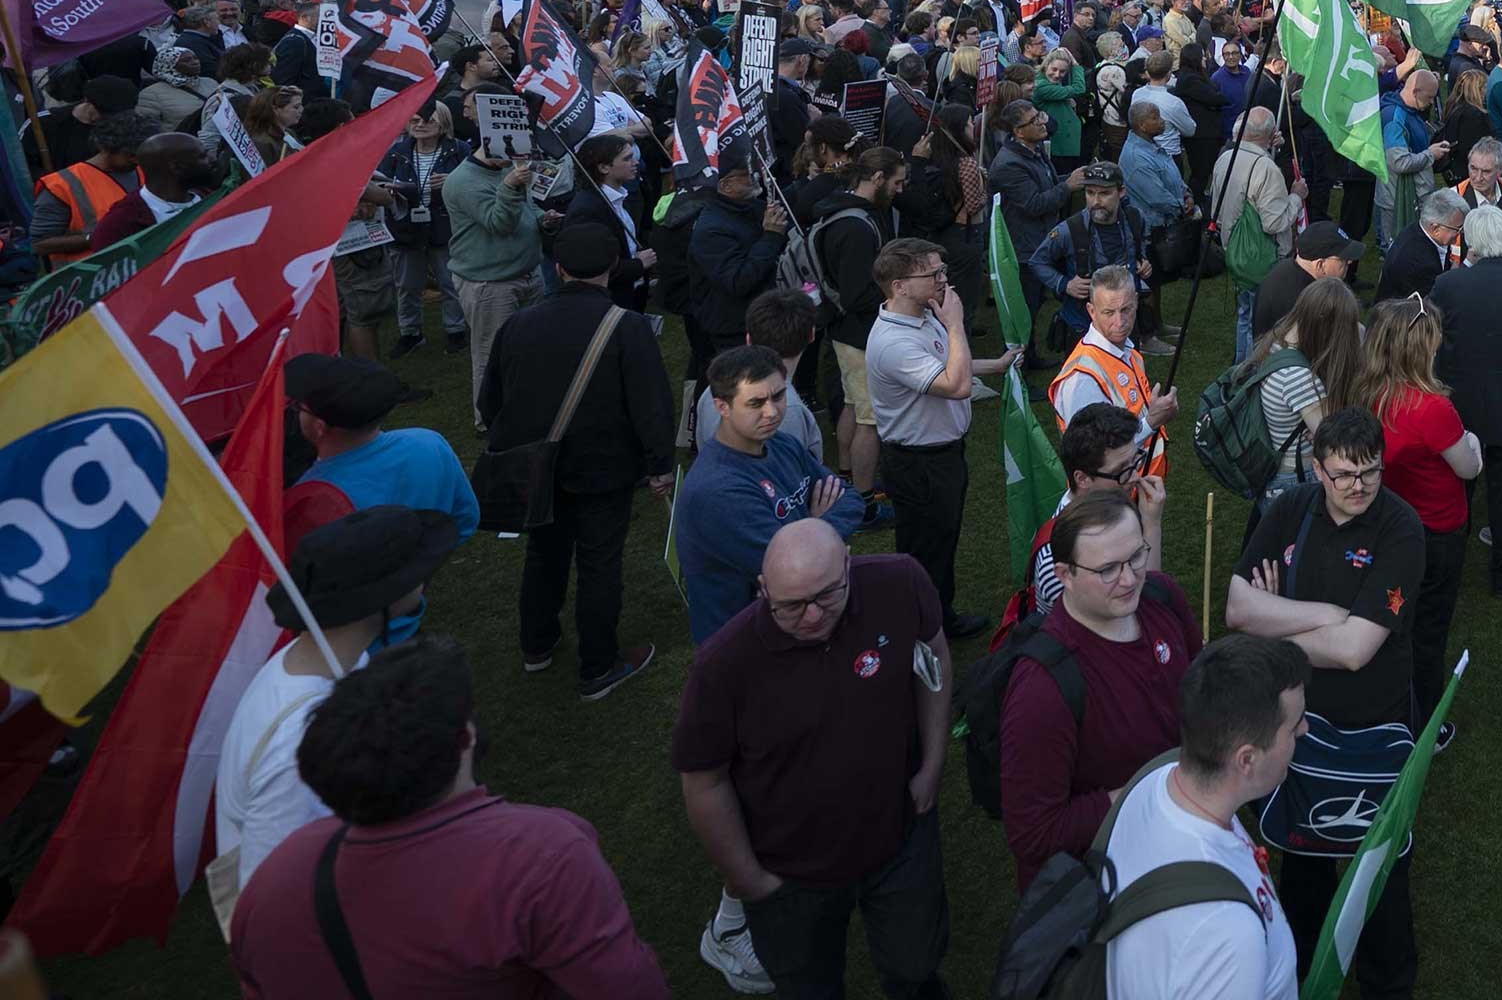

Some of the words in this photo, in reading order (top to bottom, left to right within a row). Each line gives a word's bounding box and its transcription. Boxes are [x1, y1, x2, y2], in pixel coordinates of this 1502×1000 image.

[744, 14, 777, 40] DEFEND
[742, 38, 776, 69] RIGHT
[739, 66, 774, 94] STRIKE
[489, 98, 526, 106] DEFE
[491, 110, 528, 119] RIGH
[745, 99, 765, 125] RIGHT
[748, 116, 768, 138] STRIKE
